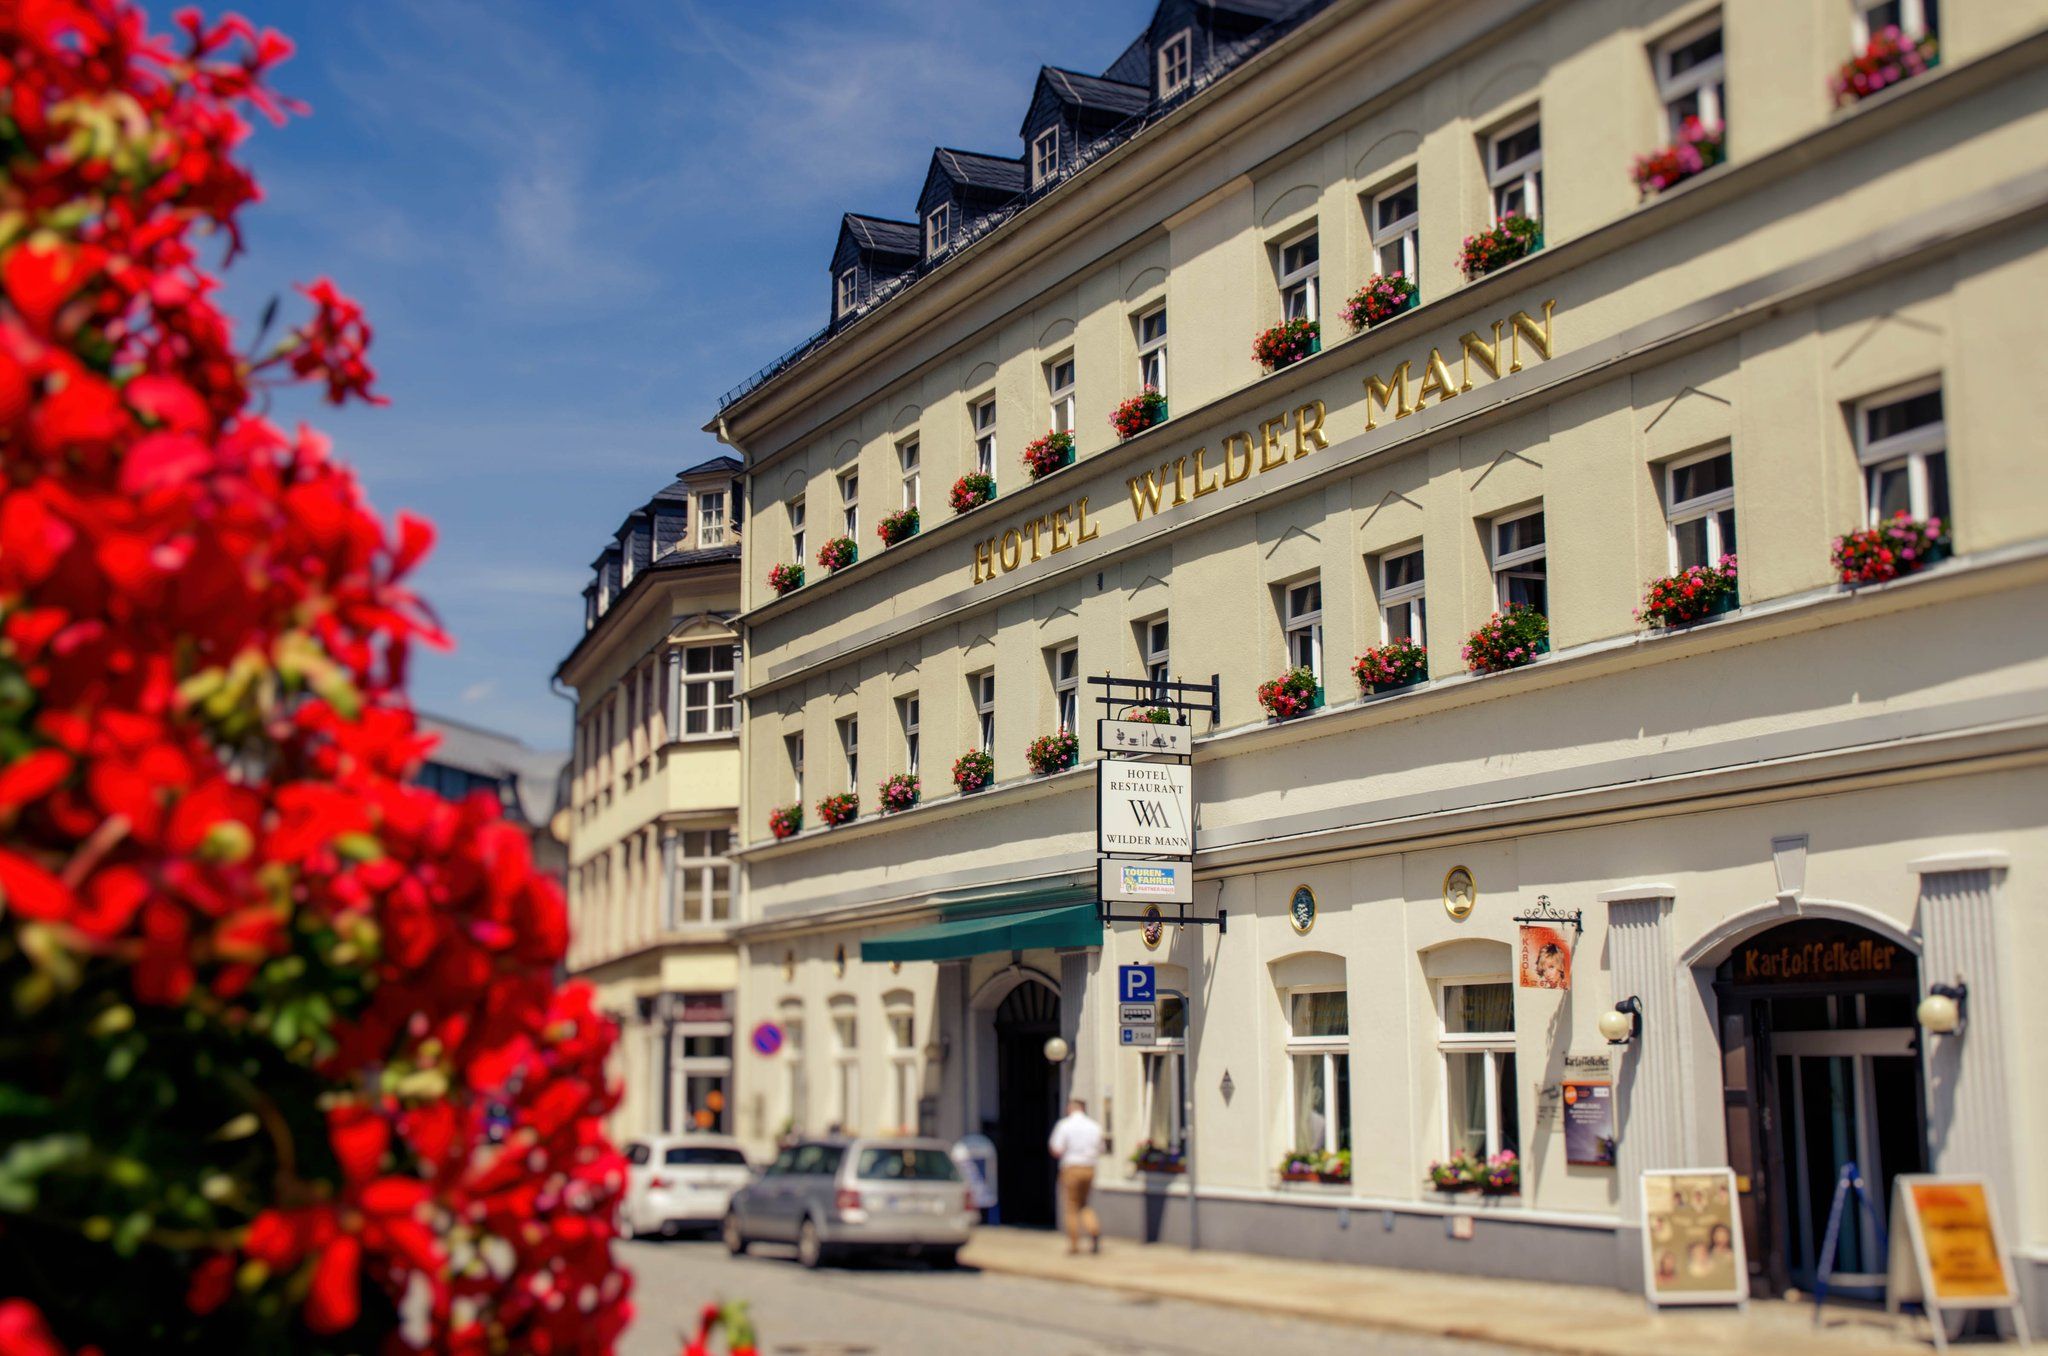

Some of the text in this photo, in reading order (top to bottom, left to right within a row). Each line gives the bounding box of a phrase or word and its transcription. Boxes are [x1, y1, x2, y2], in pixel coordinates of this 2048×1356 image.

[973, 299, 1557, 585] HOTEL WILDER MANN
[1127, 769, 1167, 780] HOTEL
[1110, 781, 1184, 794] RESTAURANT
[1106, 834, 1188, 846] WILDER MANN
[1124, 868, 1165, 877] TOUREN-
[1138, 876, 1174, 885] FAHRER
[1745, 939, 1896, 978] Kartoffelkeller
[1127, 969, 1147, 998] P
